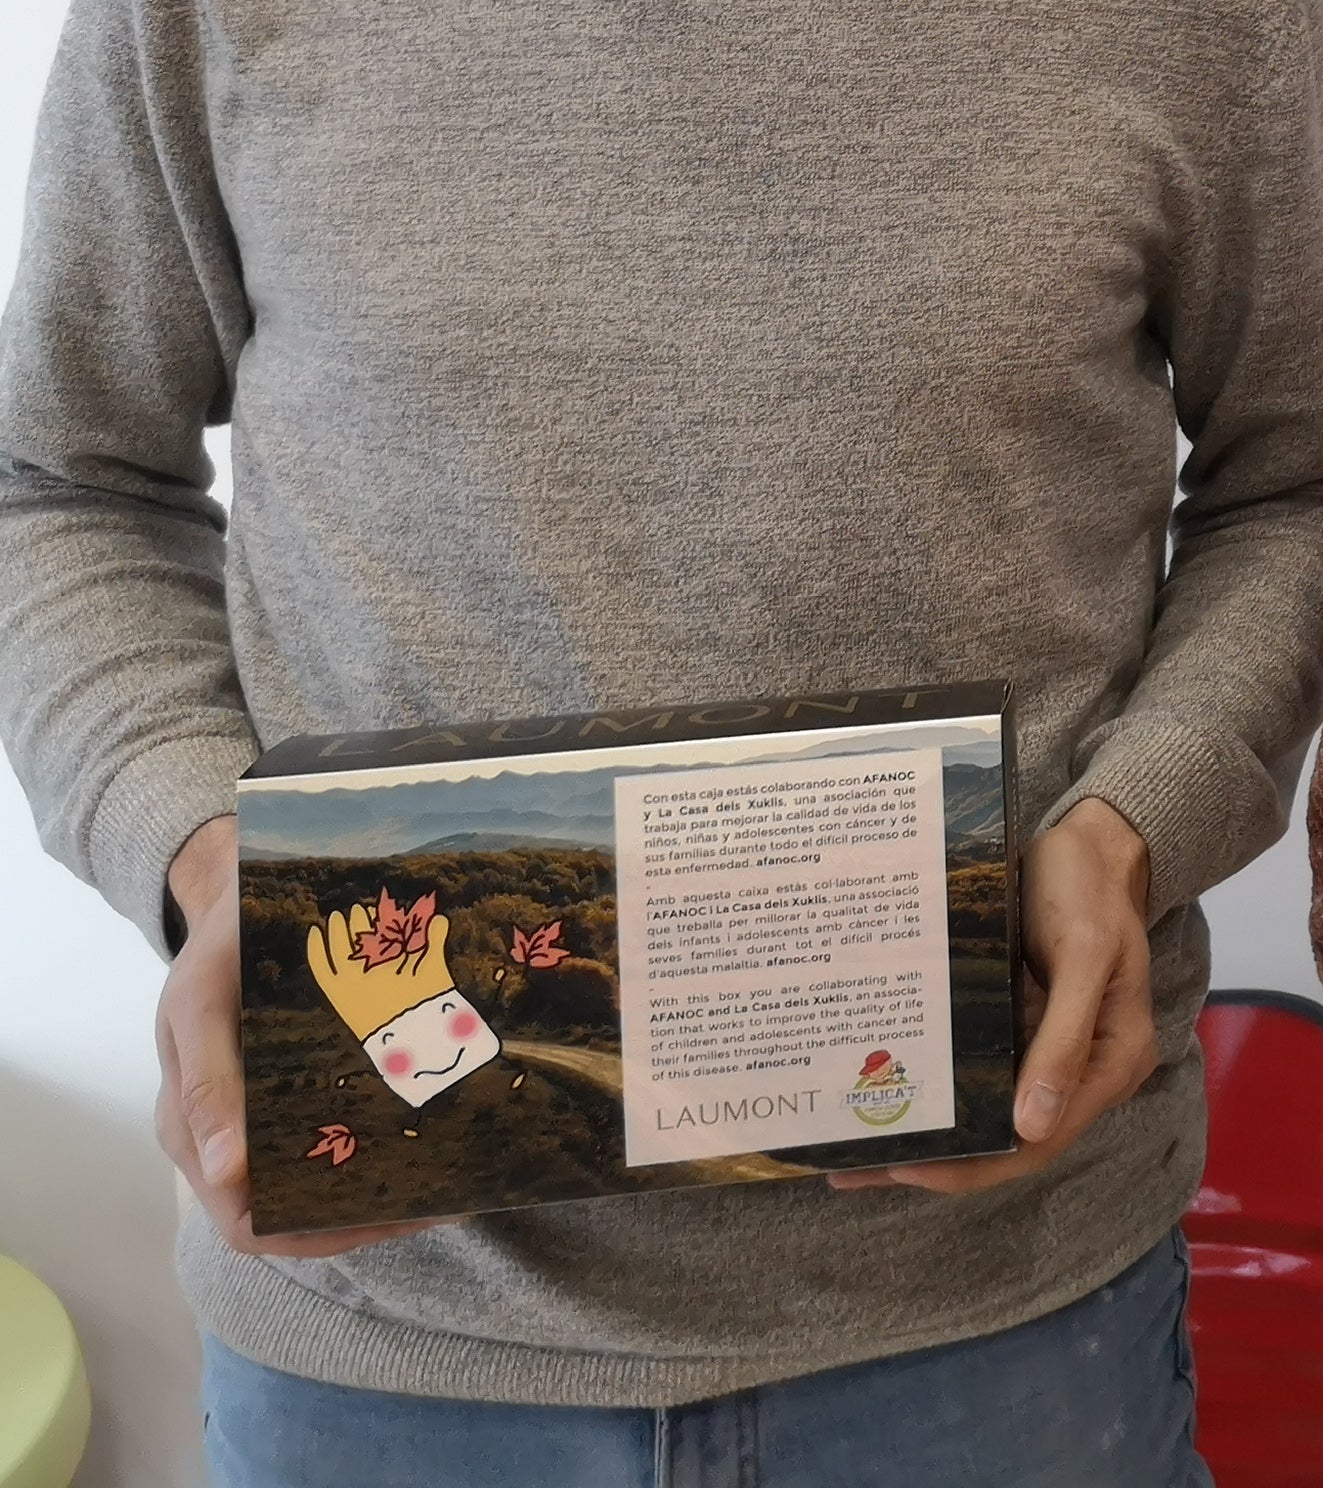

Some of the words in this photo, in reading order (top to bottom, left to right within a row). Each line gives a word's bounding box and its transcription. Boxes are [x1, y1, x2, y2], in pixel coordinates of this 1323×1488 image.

[318, 688, 952, 758] LAUMONT
[643, 794, 669, 804] Con
[671, 791, 697, 802] esta
[698, 789, 724, 801] caja
[760, 778, 836, 794] colaborando
[838, 777, 861, 786] con
[863, 771, 915, 784] AFANOC
[643, 812, 651, 821] y
[658, 808, 672, 818] La
[679, 806, 709, 815] Casa
[716, 801, 741, 812] dels
[793, 796, 817, 805] una
[893, 787, 916, 797] que
[644, 821, 687, 833] trabaja
[690, 819, 718, 831] para
[722, 815, 768, 827] mejorar
[772, 811, 783, 822] la
[785, 806, 830, 820] calidad
[833, 805, 849, 816] de
[852, 803, 877, 814] vida
[880, 801, 896, 811] de
[899, 800, 916, 810] los
[686, 832, 718, 844] niñas
[722, 833, 731, 843] y
[734, 824, 814, 839] adolescentes
[818, 822, 841, 831] con
[890, 817, 898, 827] y
[901, 814, 917, 824] de
[645, 854, 666, 863] sus
[669, 848, 716, 860] familias
[718, 843, 767, 855] durante
[770, 839, 799, 851] todo
[802, 837, 812, 847] el
[851, 831, 899, 844] proceso
[902, 828, 917, 838] de
[645, 867, 672, 877] esta
[756, 854, 821, 866] afanoc.org
[646, 895, 676, 906] Amb
[683, 890, 731, 904] aquesta
[738, 886, 769, 897] caixa
[892, 871, 919, 882] amb
[716, 905, 730, 914] La
[732, 903, 761, 912] Casa
[764, 899, 789, 909] dels
[834, 893, 856, 902] una
[647, 926, 671, 937] que
[677, 920, 723, 932] treballa
[729, 919, 749, 928] per
[755, 913, 801, 924] millorar
[807, 910, 817, 919] la
[822, 905, 869, 919] qualitat
[874, 903, 890, 912] de
[895, 900, 920, 910] vida
[647, 939, 673, 950] dels
[679, 935, 721, 946] infants
[736, 926, 809, 941] adolescents
[815, 922, 843, 932] amb
[904, 914, 920, 923] les
[648, 954, 682, 964] seves
[746, 942, 787, 954] durant
[795, 940, 813, 949] tot
[821, 937, 832, 946] el
[766, 953, 831, 966] afanoc.org
[649, 997, 678, 1008] With
[687, 994, 710, 1004] this
[719, 992, 741, 1001] box
[750, 989, 772, 1000] you
[781, 986, 801, 994] are
[808, 976, 888, 992] collaborating
[896, 971, 922, 981] with
[650, 1008, 704, 1023] AFANOC
[708, 1005, 731, 1016] and
[734, 1005, 748, 1013] La
[752, 1002, 781, 1011] Casa
[784, 998, 809, 1008] dels
[856, 992, 870, 1000] an
[650, 1027, 675, 1037] tion
[679, 1024, 704, 1034] that
[708, 1019, 744, 1031] works
[749, 1018, 762, 1026] to
[766, 1012, 816, 1025] improve
[820, 1008, 840, 1018] the
[844, 1004, 885, 1017] quality
[889, 1001, 901, 1010] of
[905, 999, 923, 1008] life
[651, 1041, 663, 1051] of
[668, 1038, 718, 1050] children
[722, 1033, 745, 1044] and
[750, 1025, 822, 1041] adolescents
[826, 1021, 853, 1032] with
[857, 1017, 897, 1028] cancer
[901, 1012, 924, 1024] and
[651, 1055, 680, 1066] their
[683, 1050, 730, 1063] families
[734, 1041, 803, 1057] throughout
[806, 1039, 826, 1049] the
[829, 1033, 874, 1046] difficult
[878, 1029, 925, 1042] process
[652, 1071, 664, 1081] of
[668, 1069, 690, 1079] this
[746, 1056, 811, 1070] afanoc.org
[656, 1089, 822, 1131] LAUMONT
[846, 1084, 918, 1104] IMPLICA'T
